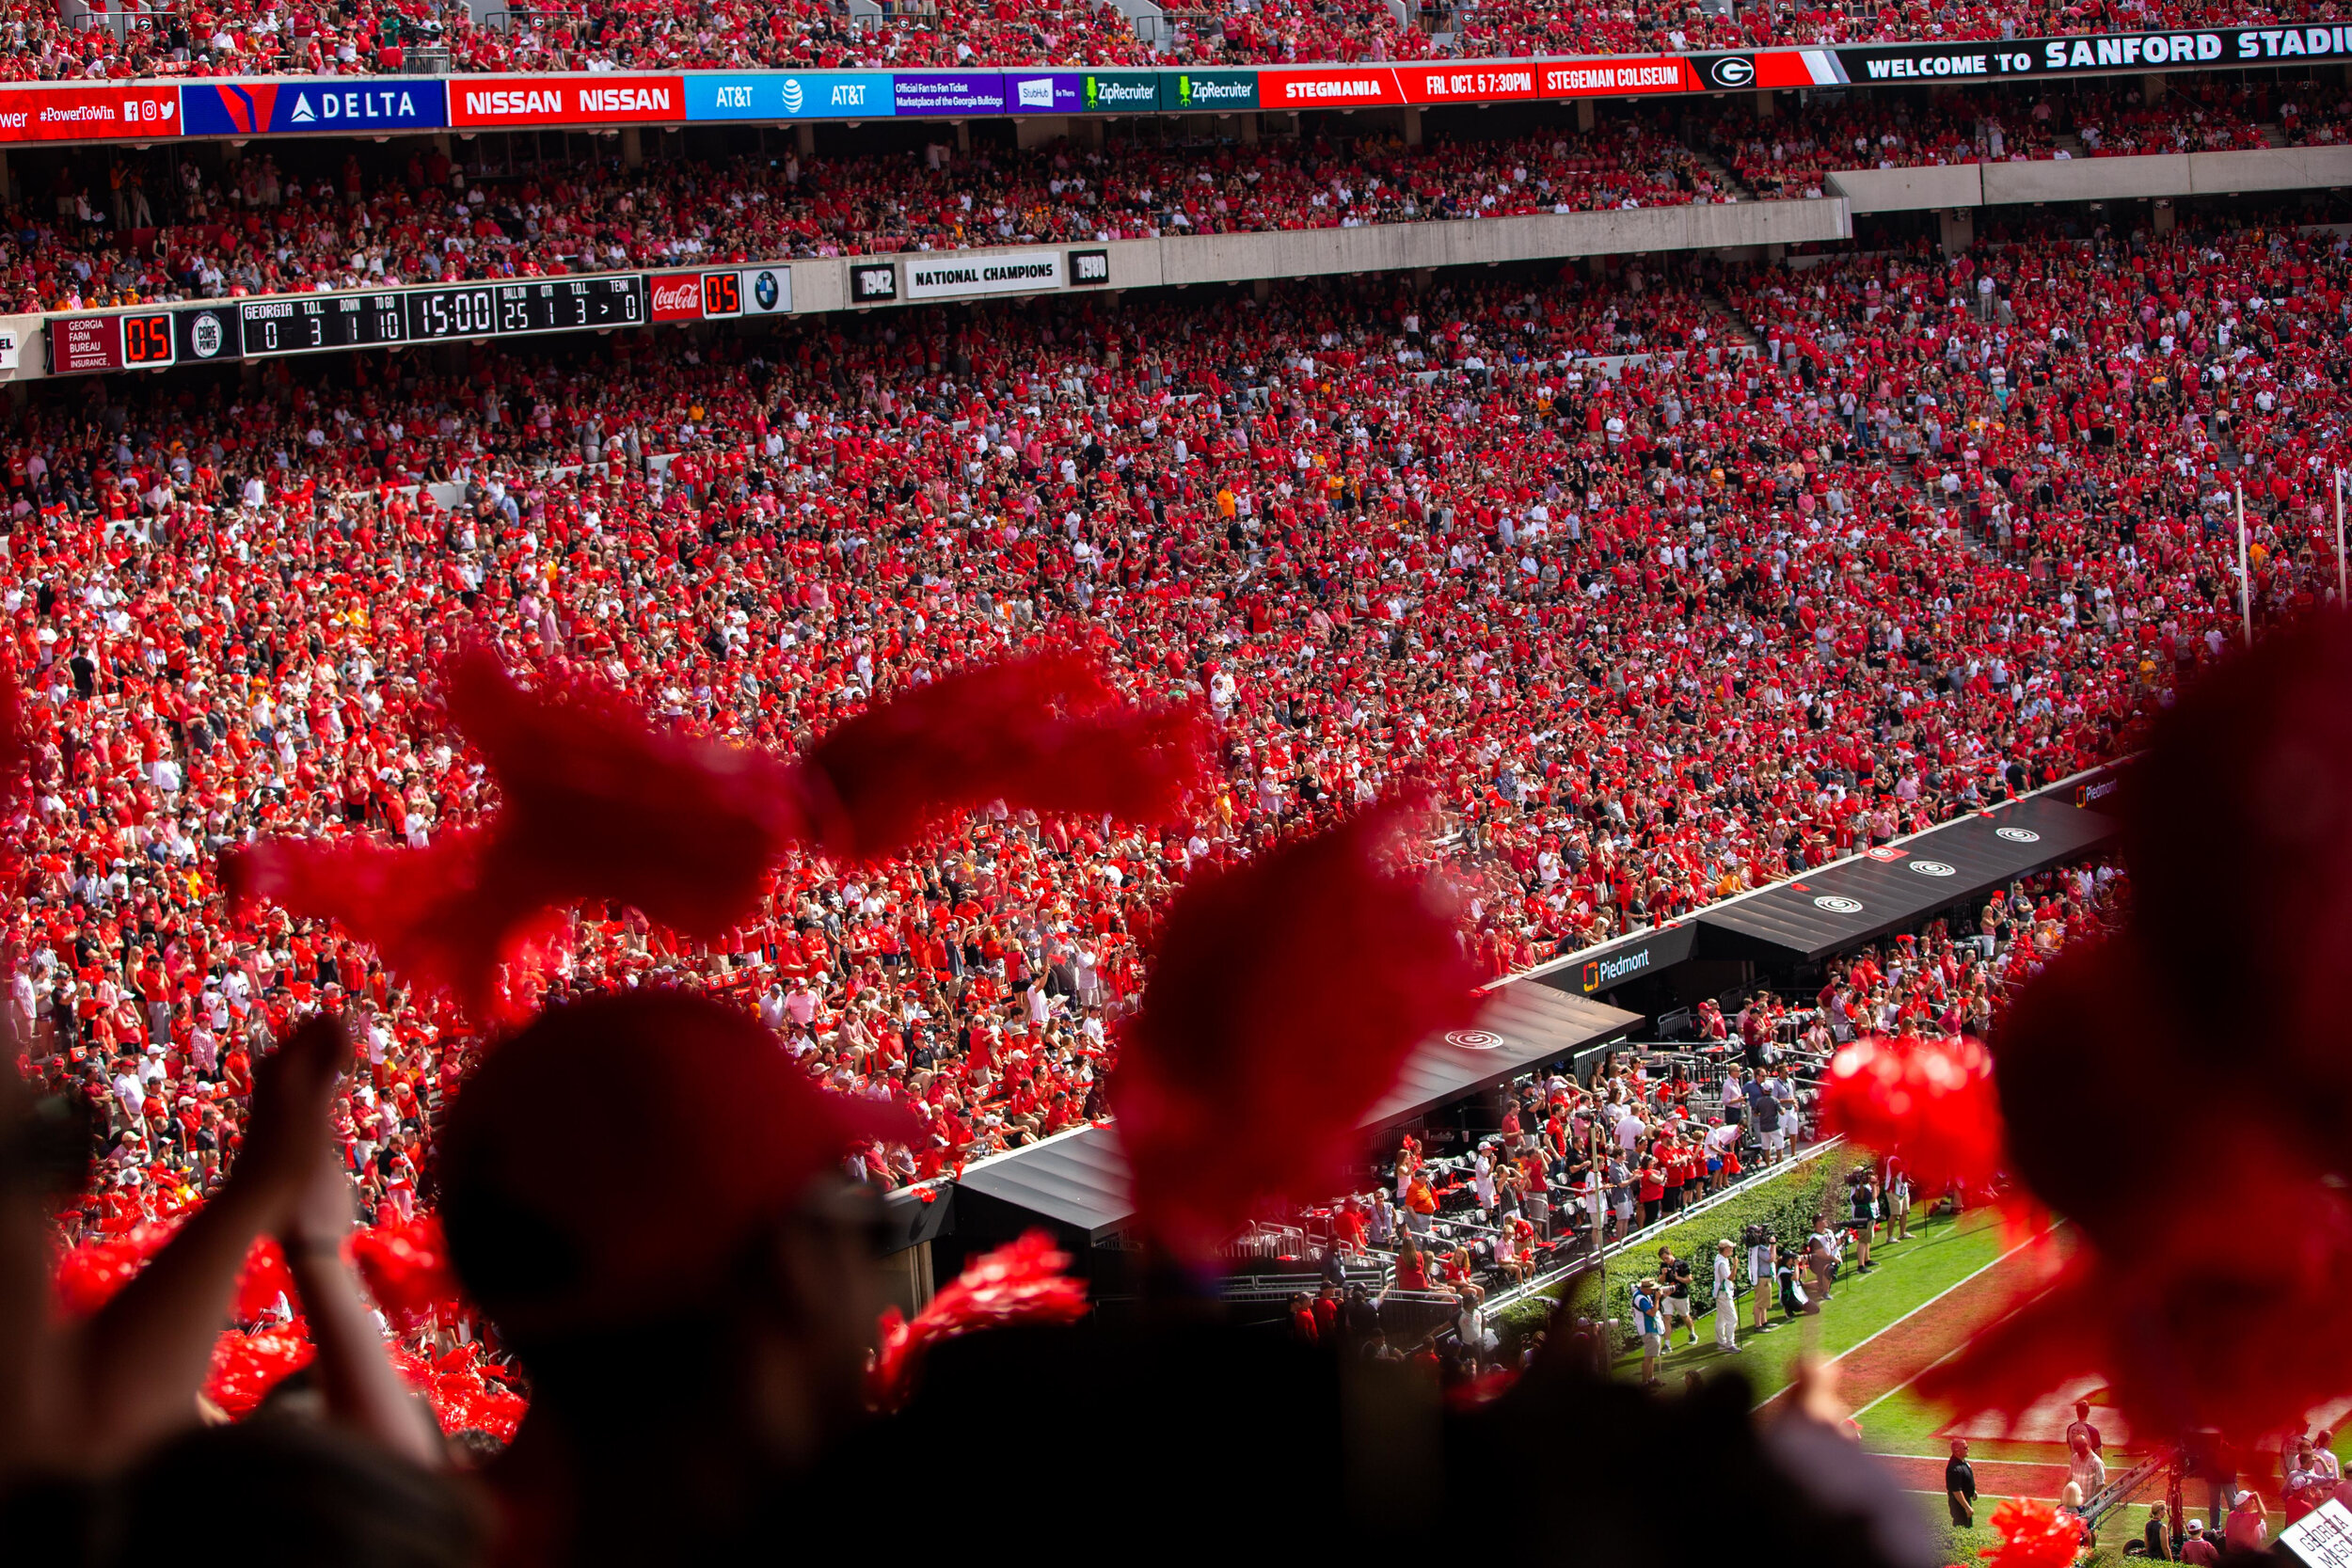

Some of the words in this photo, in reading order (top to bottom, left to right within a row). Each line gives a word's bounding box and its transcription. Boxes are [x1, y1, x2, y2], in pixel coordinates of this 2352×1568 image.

[1867, 55, 1987, 78] WELCOME
[2045, 34, 2222, 68] SANFORD
[2238, 26, 2352, 58] STADI
[895, 83, 917, 93] Official
[918, 83, 930, 92] Fan
[930, 83, 937, 92] to
[937, 83, 949, 92] Fan
[949, 83, 968, 92] Ticket
[1285, 80, 1381, 98] STEGMANIA
[1426, 75, 1449, 95] FRI.
[1451, 74, 1476, 94] OCT.
[1477, 74, 1486, 92] 5
[1487, 71, 1532, 92] 7:30PM
[1547, 70, 1614, 90] STEGEMAN
[1617, 66, 1679, 87] COLISEUM
[466, 90, 562, 114] NISSAN
[579, 88, 670, 112] NISSAN
[716, 87, 753, 107] AT&T
[831, 85, 866, 105] AT&T
[896, 96, 934, 108] Marketplace
[935, 96, 942, 106] of
[942, 97, 952, 106] the
[952, 96, 977, 107] Georgia
[977, 95, 1003, 107] Bulldogs
[1023, 87, 1049, 98] StubHub
[1097, 82, 1154, 104] ZipRecruiter
[1191, 81, 1252, 103] ZipRecruiter
[40, 105, 115, 121] #PowerToWin
[323, 91, 415, 119] DELTA
[915, 269, 978, 286] NATIONAL
[983, 263, 1053, 280] CHAMPIONS
[1077, 255, 1106, 278] 1980
[540, 284, 553, 297] QTR
[570, 282, 590, 295] T.O.L.
[610, 279, 629, 293] TENN
[861, 270, 893, 293] 1942
[374, 297, 384, 309] TO
[384, 295, 395, 309] GO
[502, 287, 517, 300] BALL
[517, 286, 527, 298] ON
[653, 283, 700, 311] Coca-Cola
[707, 275, 739, 312] 05
[244, 303, 294, 320] GEORGIA
[302, 301, 325, 315] T.O.L.
[340, 298, 360, 312] DOWN
[422, 293, 490, 333] 15:00
[504, 302, 528, 329] 25
[549, 302, 554, 325] 1
[576, 298, 586, 324] 3
[625, 294, 636, 320] 0
[69, 319, 103, 331] GEORGIA
[69, 331, 90, 341] FARM
[198, 325, 216, 340] CORE
[265, 322, 278, 349] 0
[310, 318, 322, 345] 3
[353, 316, 358, 340] 1
[380, 312, 398, 339] 10
[70, 341, 101, 353] BUREAU
[127, 317, 168, 360] 05
[199, 339, 217, 350] POWER
[71, 357, 107, 369] INSURANCE
[2312, 529, 2322, 538] 34
[1599, 948, 1649, 982] Piedmont
[2299, 1514, 2349, 1552] GEORGIA
